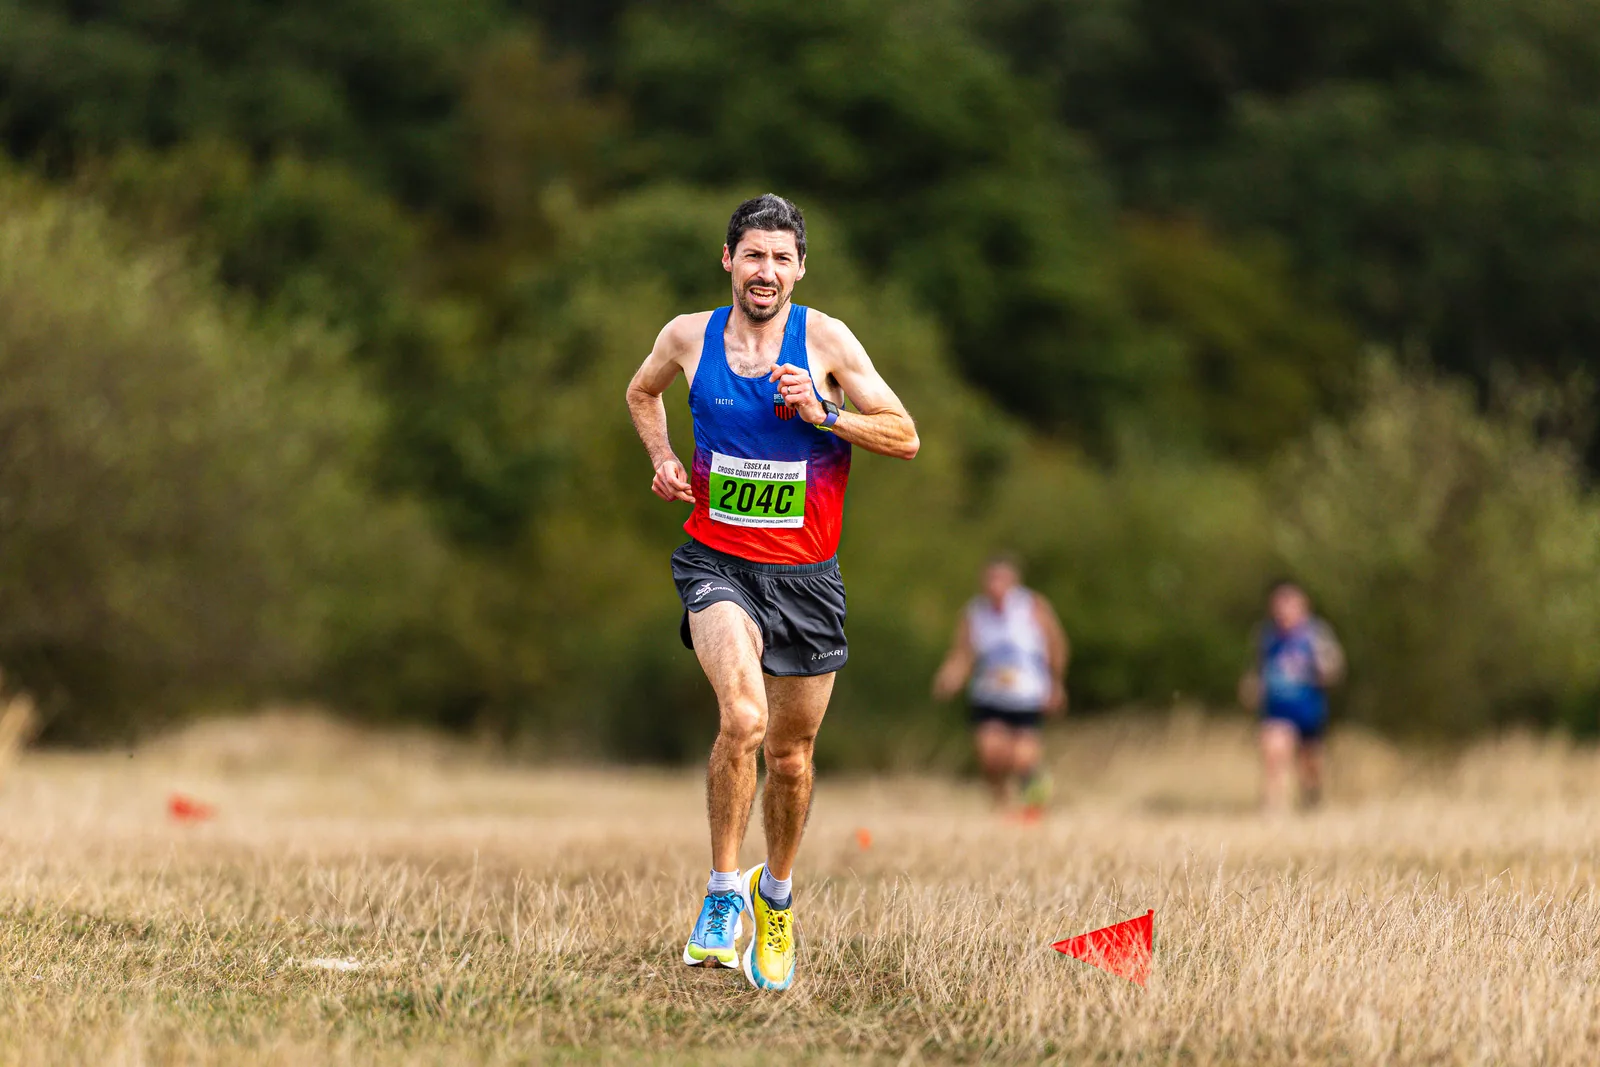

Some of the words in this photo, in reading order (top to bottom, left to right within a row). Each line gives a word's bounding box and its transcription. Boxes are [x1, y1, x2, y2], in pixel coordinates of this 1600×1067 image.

[715, 398, 734, 406] TACTIC
[743, 462, 762, 470] ESSEX
[717, 465, 735, 475] CROSS
[735, 469, 761, 478] COUNTRY
[762, 471, 784, 480] RELAYS
[719, 480, 795, 514] 204C
[818, 650, 844, 660] KUKRI
